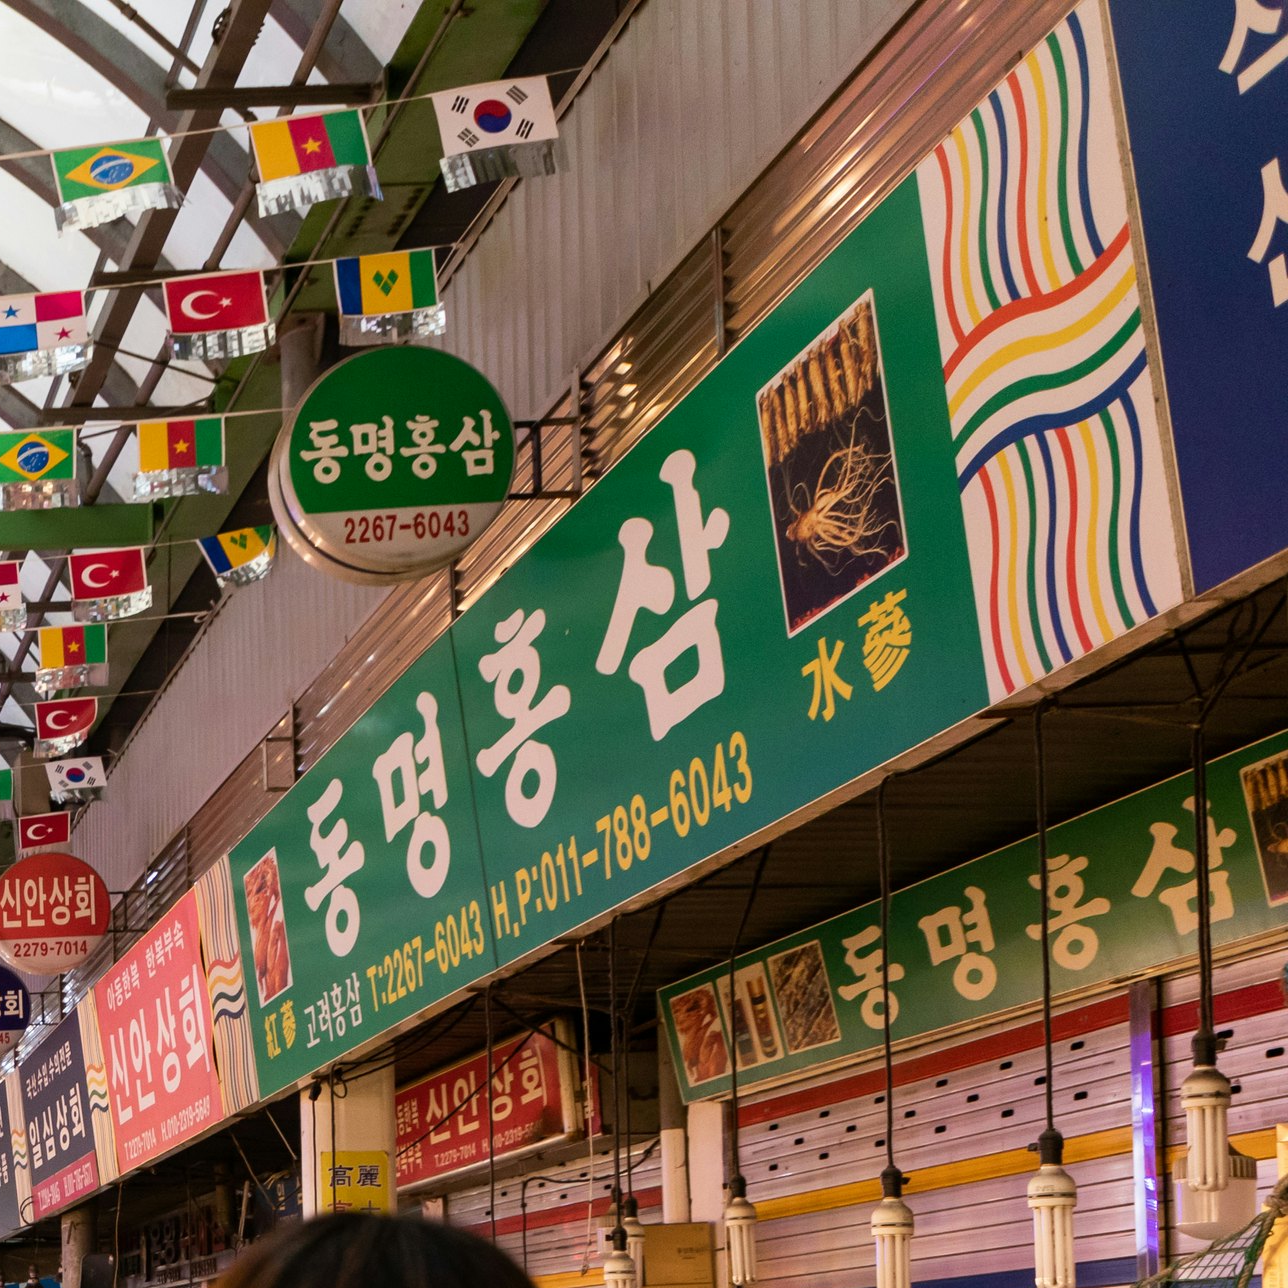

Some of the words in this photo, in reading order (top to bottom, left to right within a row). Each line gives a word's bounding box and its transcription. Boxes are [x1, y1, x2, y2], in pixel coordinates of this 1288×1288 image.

[299, 411, 501, 485] 동명홍삼
[344, 508, 471, 545] 2267-6043
[304, 449, 730, 957] 동명홍삼
[0, 874, 96, 929] 신안상회
[838, 796, 1238, 1030] 동명홍삼
[13, 941, 88, 958] 2279-7014
[106, 959, 141, 1012] 아동한복
[145, 919, 185, 979] 한복부속
[304, 971, 363, 1049] 고려홍삼
[366, 899, 487, 1012] T:2267-6043
[109, 963, 211, 1125] 신안상회
[28, 1081, 87, 1170] 일심상회
[396, 1097, 420, 1138] 동한복
[425, 1041, 549, 1146] 신안상회
[328, 1164, 382, 1188] 高麗
